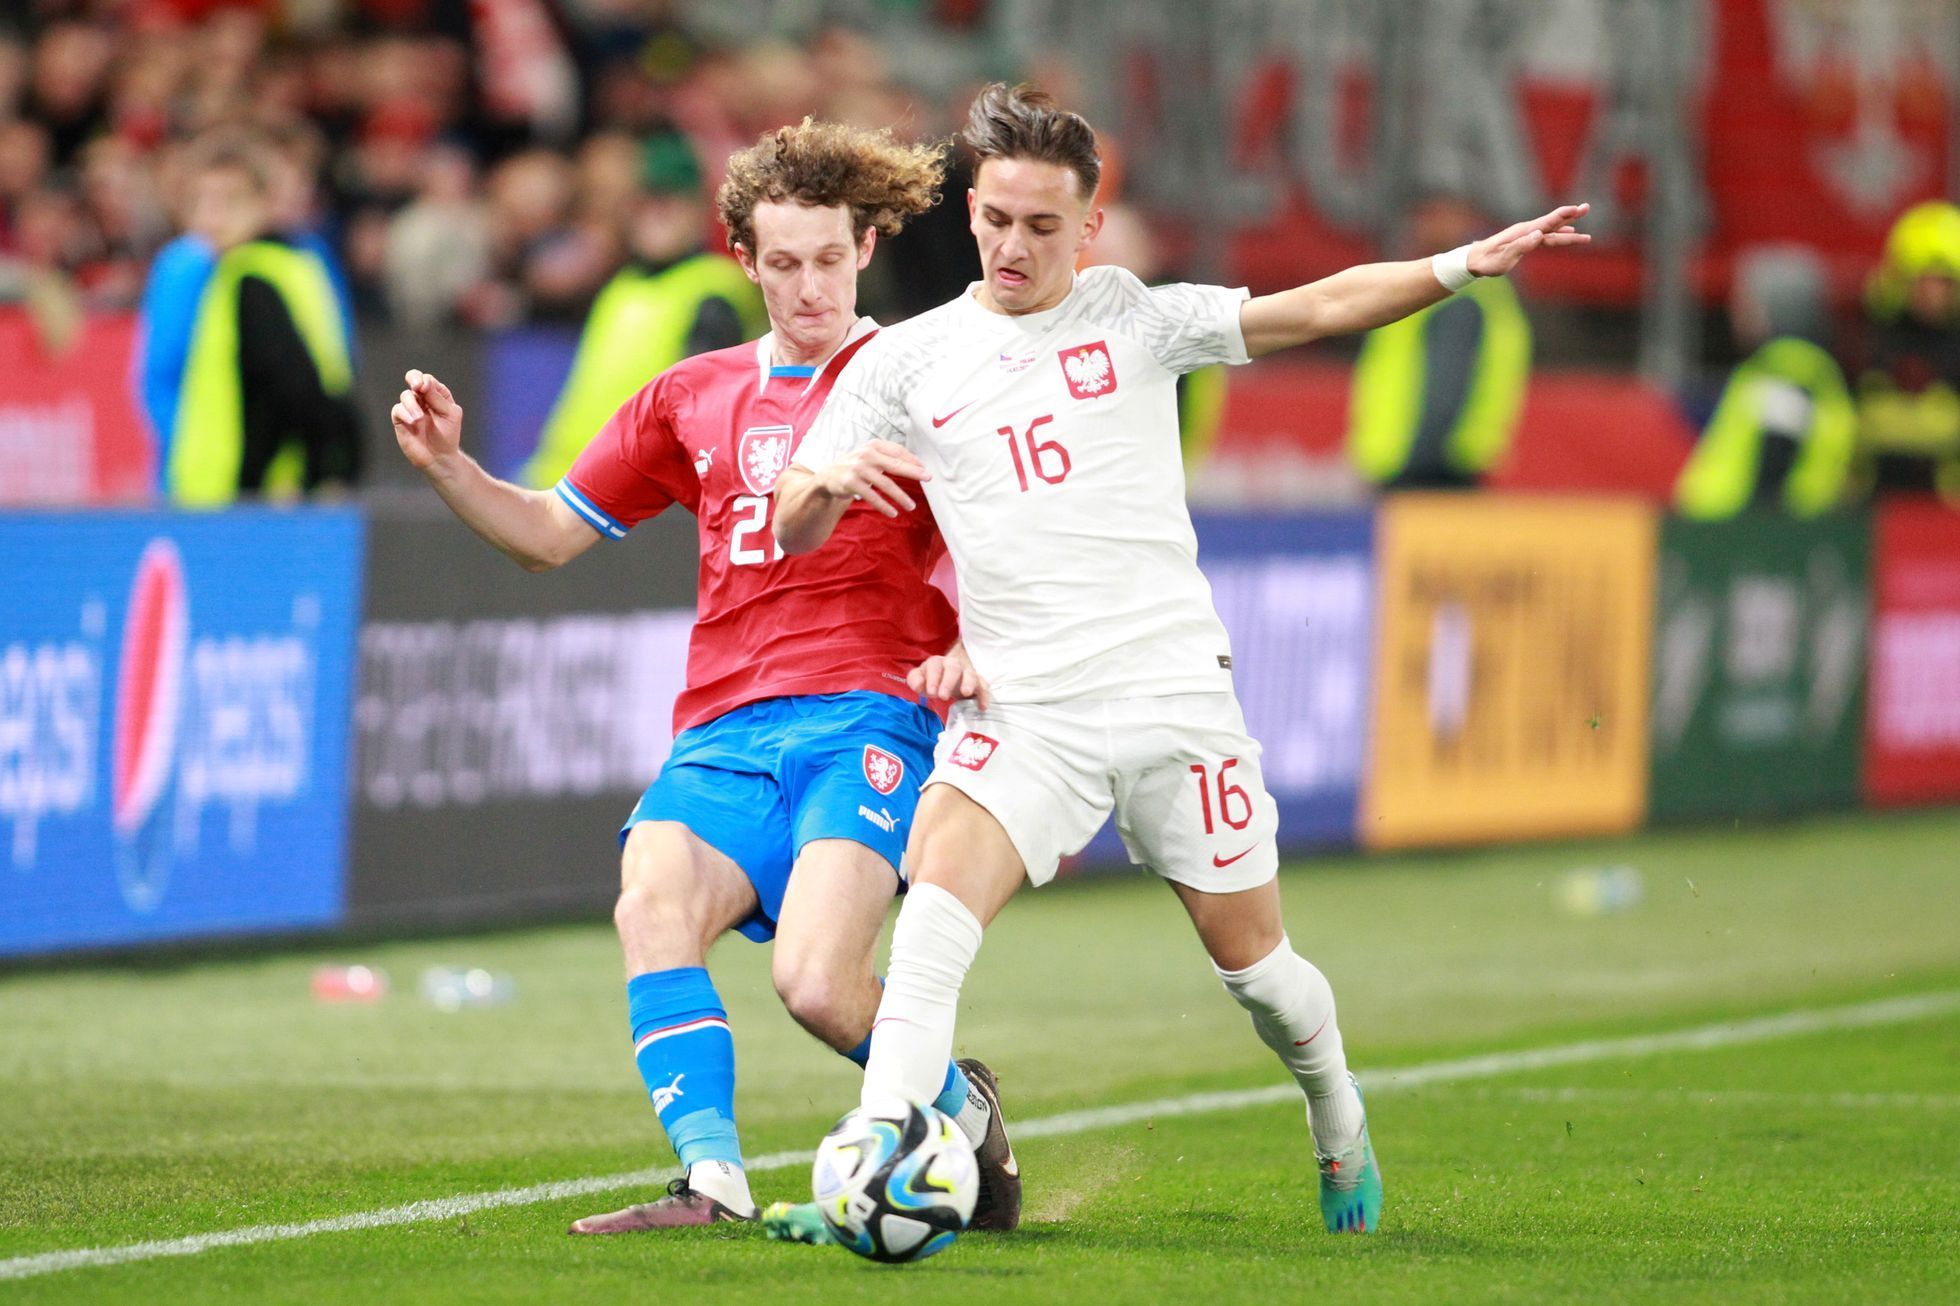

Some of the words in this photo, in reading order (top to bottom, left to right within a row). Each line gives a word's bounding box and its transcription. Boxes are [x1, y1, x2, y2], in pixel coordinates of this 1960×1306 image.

[997, 414, 1072, 493] 16
[730, 495, 785, 566] 2
[857, 804, 890, 833] PUMA
[1190, 758, 1254, 835] 16
